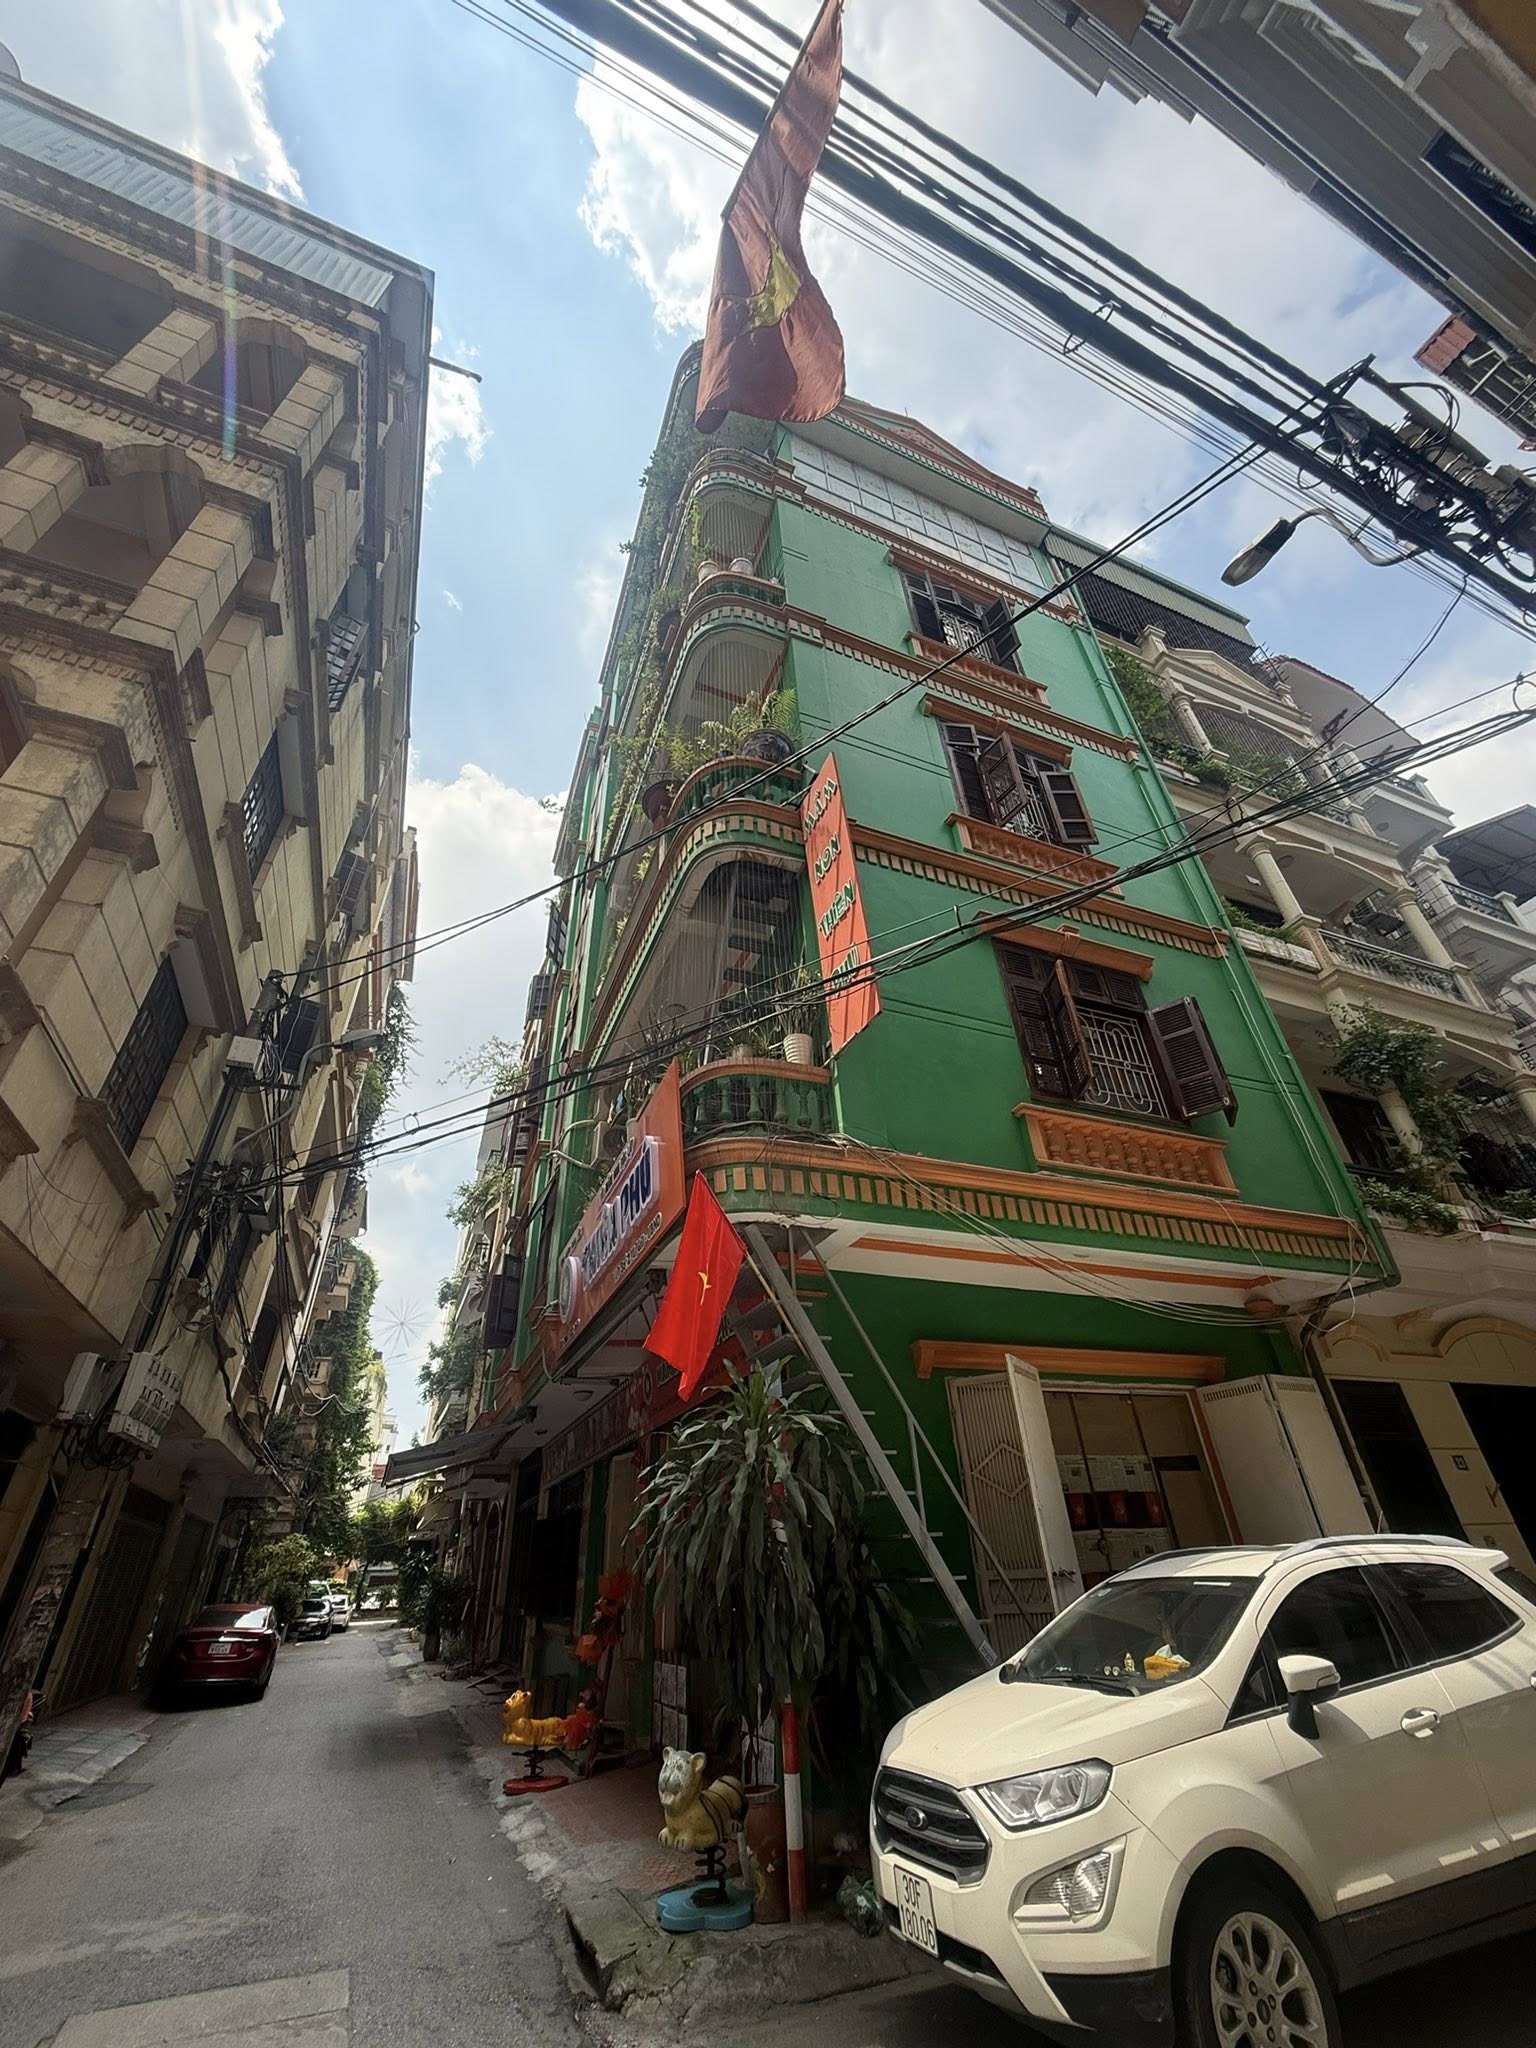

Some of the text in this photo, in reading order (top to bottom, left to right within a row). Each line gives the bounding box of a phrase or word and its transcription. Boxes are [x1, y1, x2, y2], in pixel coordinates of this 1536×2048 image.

[814, 834, 841, 883] NON
[818, 880, 855, 940] THIÊN
[620, 1138, 652, 1239] PHÚ
[903, 1876, 921, 1909] 30F
[902, 1905, 936, 1949] 180.06
